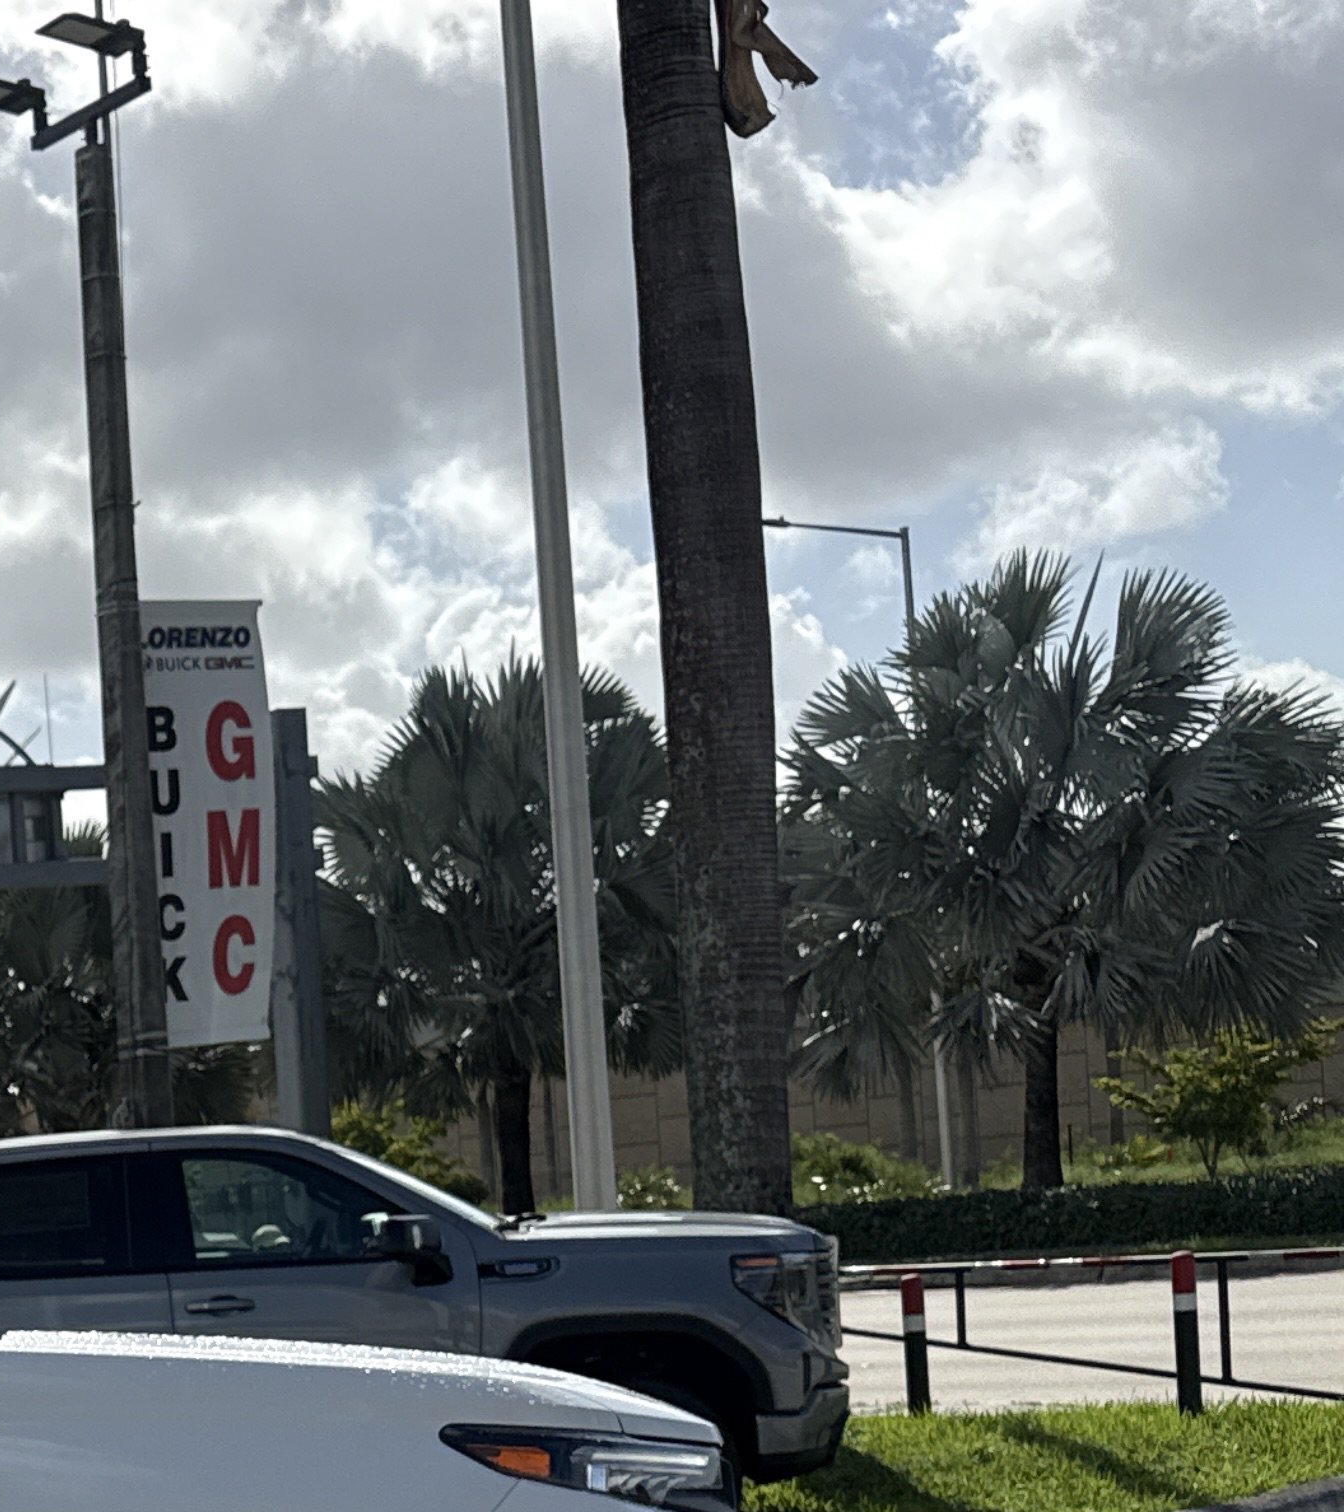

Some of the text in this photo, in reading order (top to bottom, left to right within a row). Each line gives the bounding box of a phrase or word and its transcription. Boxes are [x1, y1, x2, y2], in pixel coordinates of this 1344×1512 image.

[142, 626, 251, 649] ORENZO
[156, 655, 255, 672] BUICK GMC
[205, 700, 261, 995] GMC
